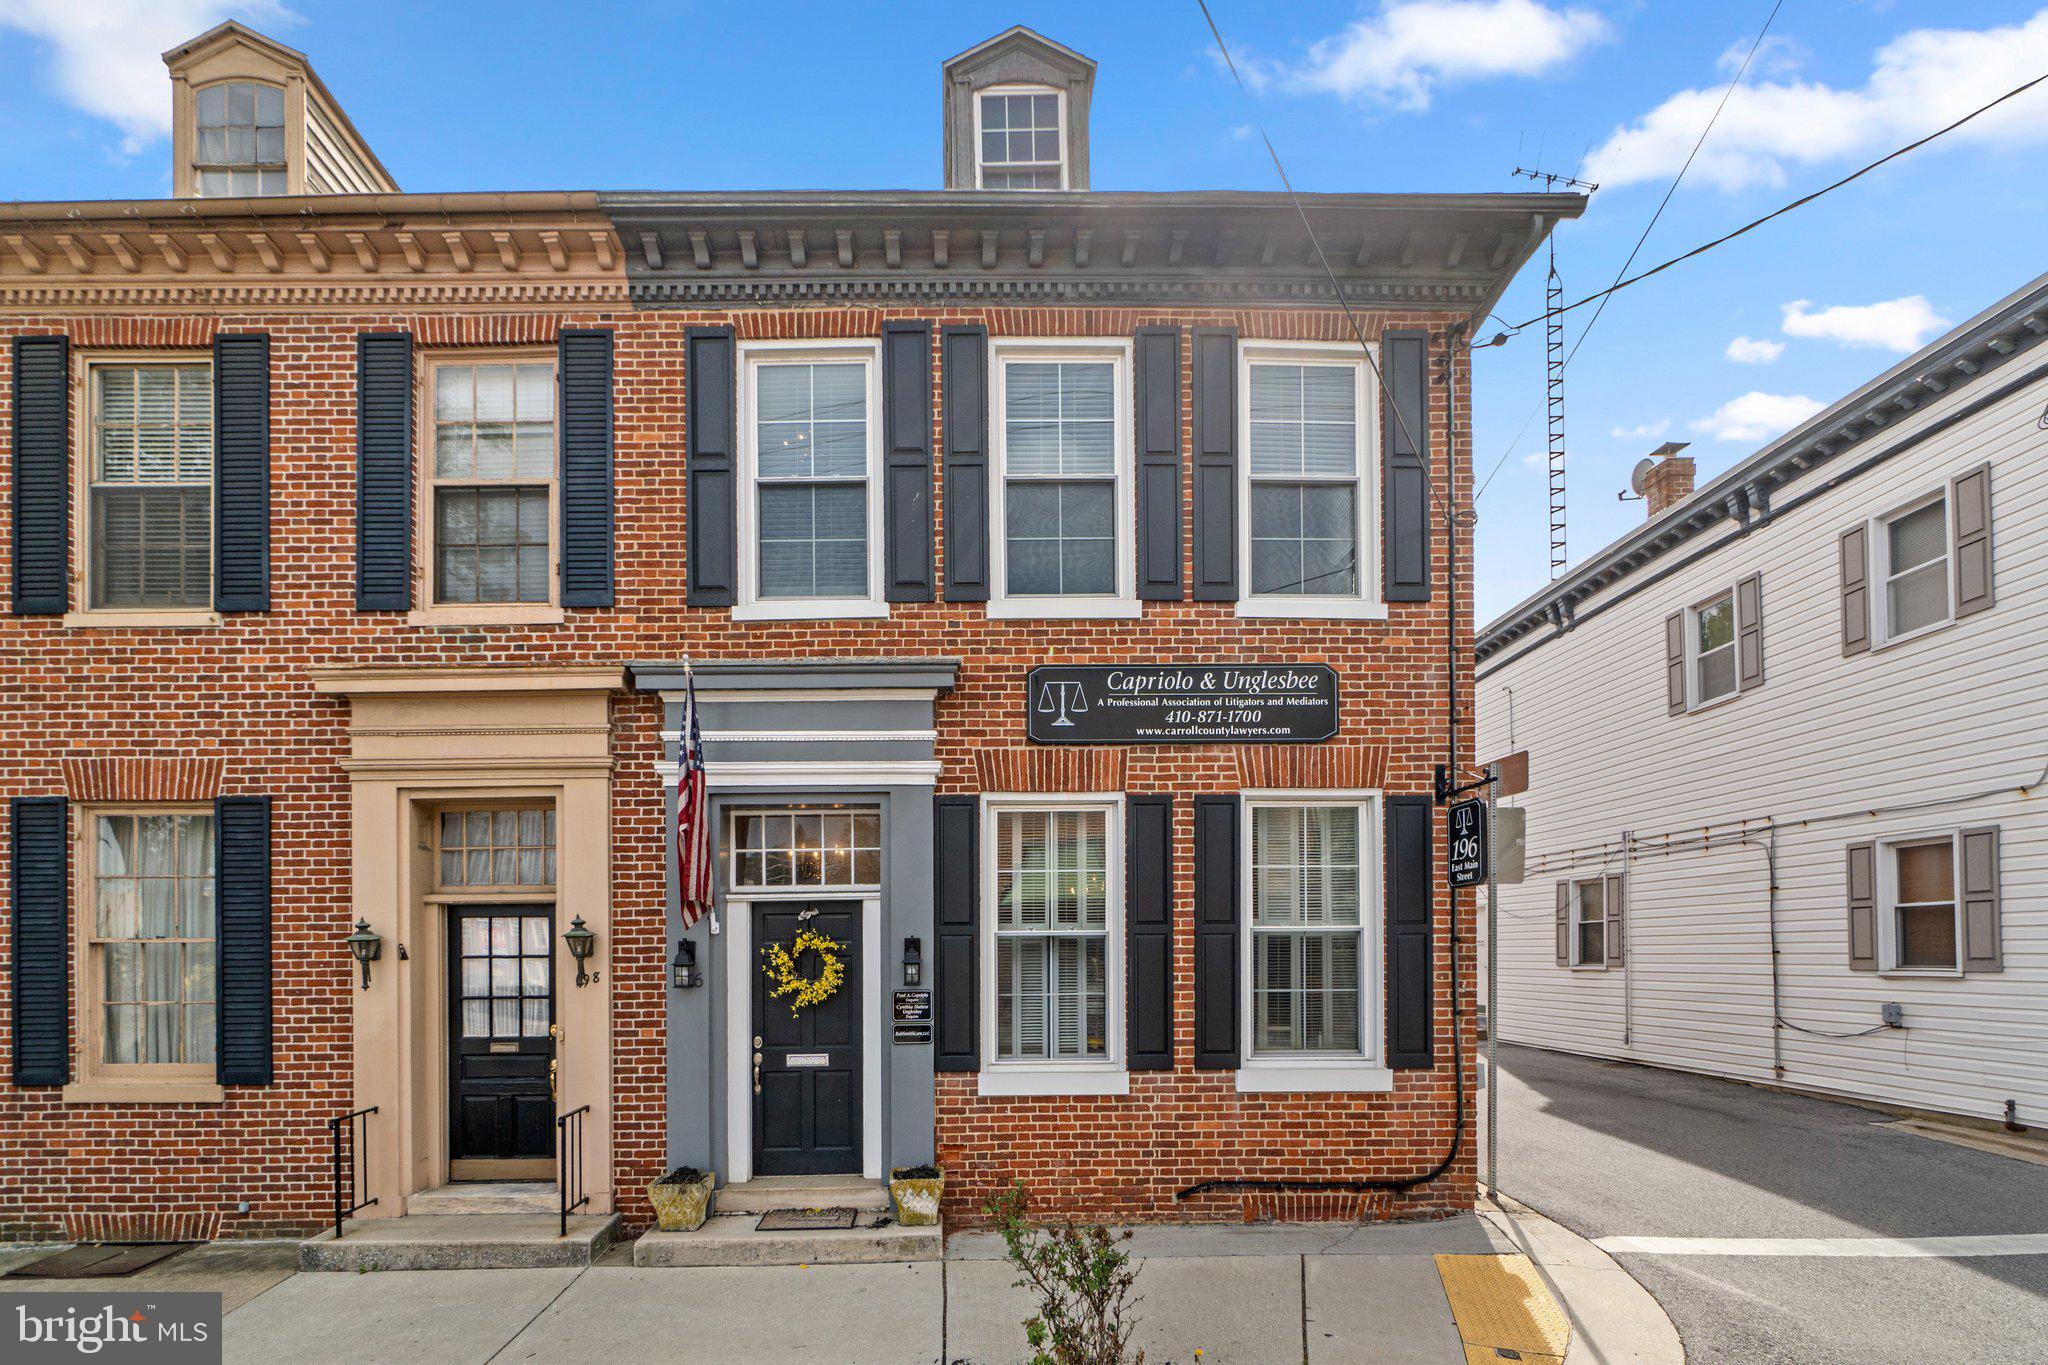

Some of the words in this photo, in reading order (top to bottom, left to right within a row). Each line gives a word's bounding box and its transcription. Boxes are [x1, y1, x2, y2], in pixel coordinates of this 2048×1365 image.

[1107, 671, 1193, 694] Capriolo
[1199, 671, 1217, 690] &
[1223, 671, 1319, 694] Unglesbee
[1097, 697, 1105, 706] A
[1107, 697, 1159, 706] Professional
[1161, 697, 1211, 706] Association
[1214, 697, 1223, 706] of
[1225, 697, 1265, 708] Litigators
[1267, 697, 1285, 706] and
[1287, 697, 1329, 706] Mediators
[1165, 710, 1262, 724] 410-871-1700
[1136, 725, 1291, 737] www.carrollcountylawyers.com
[1451, 836, 1478, 861] 196
[1451, 863, 1463, 873] East
[1464, 860, 1478, 870] Main
[1457, 872, 1473, 882] Street
